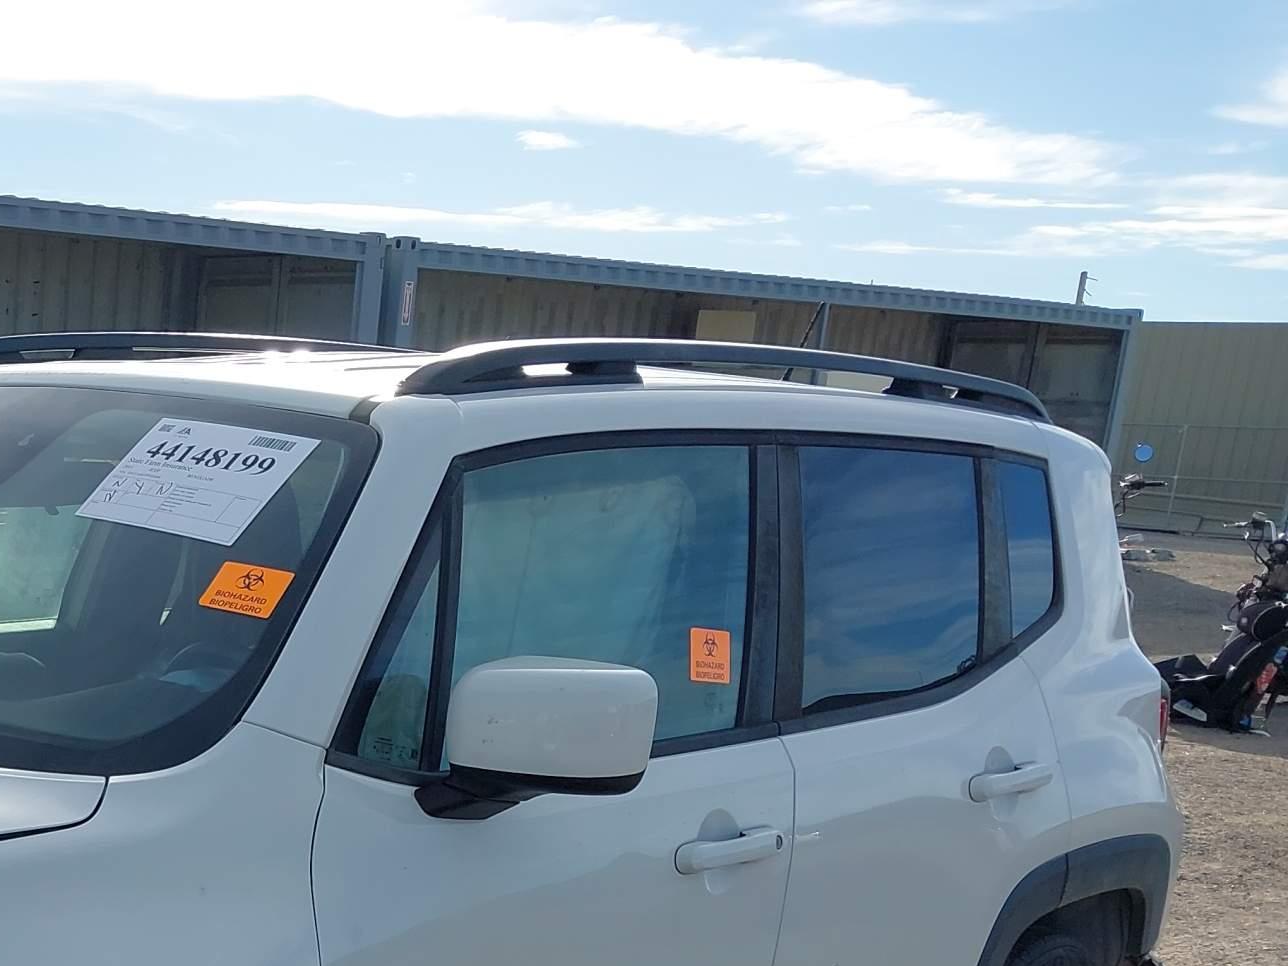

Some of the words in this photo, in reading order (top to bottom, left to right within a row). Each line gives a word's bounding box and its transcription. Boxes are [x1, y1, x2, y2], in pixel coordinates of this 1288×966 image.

[146, 440, 276, 476] 44148199
[215, 589, 268, 605] BIOHAZARD
[209, 598, 262, 614] BIOPELIGRO
[695, 660, 726, 671] BIOHAZARD
